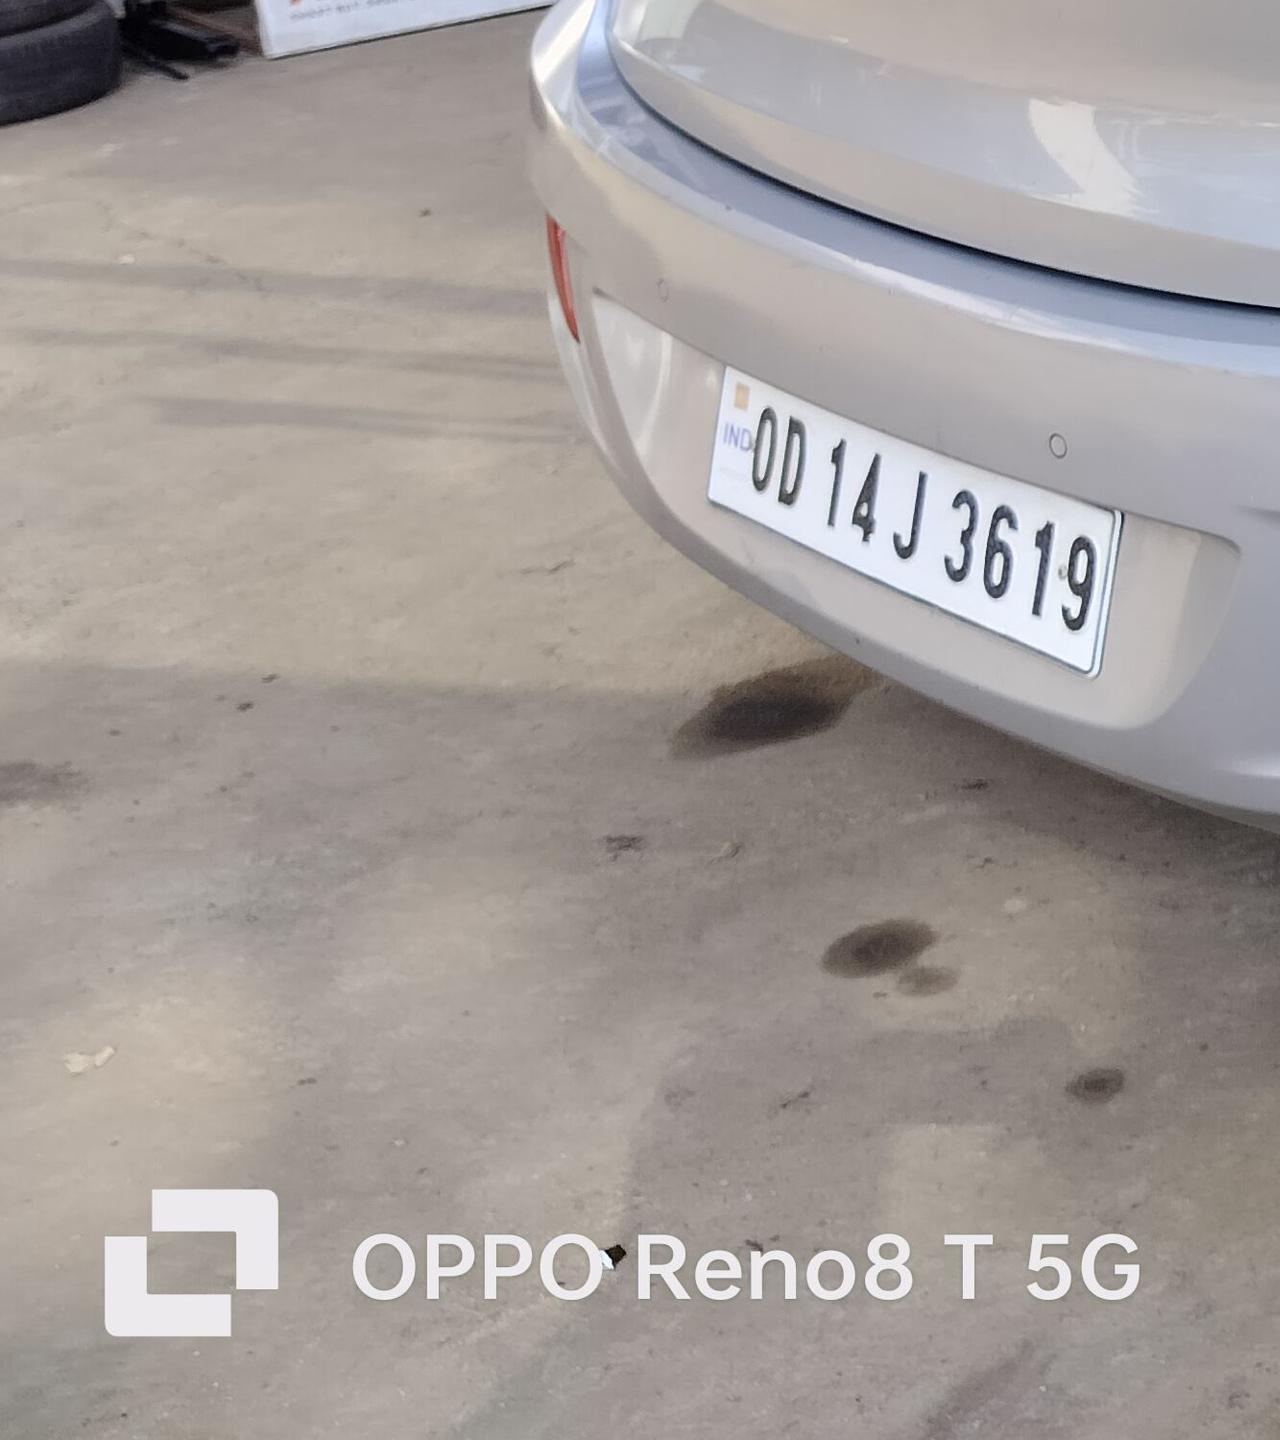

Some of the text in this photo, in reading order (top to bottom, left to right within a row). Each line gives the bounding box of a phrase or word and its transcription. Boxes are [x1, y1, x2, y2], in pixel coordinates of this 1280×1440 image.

[723, 422, 753, 452] IND
[751, 405, 1097, 631] OD 14 J 3619
